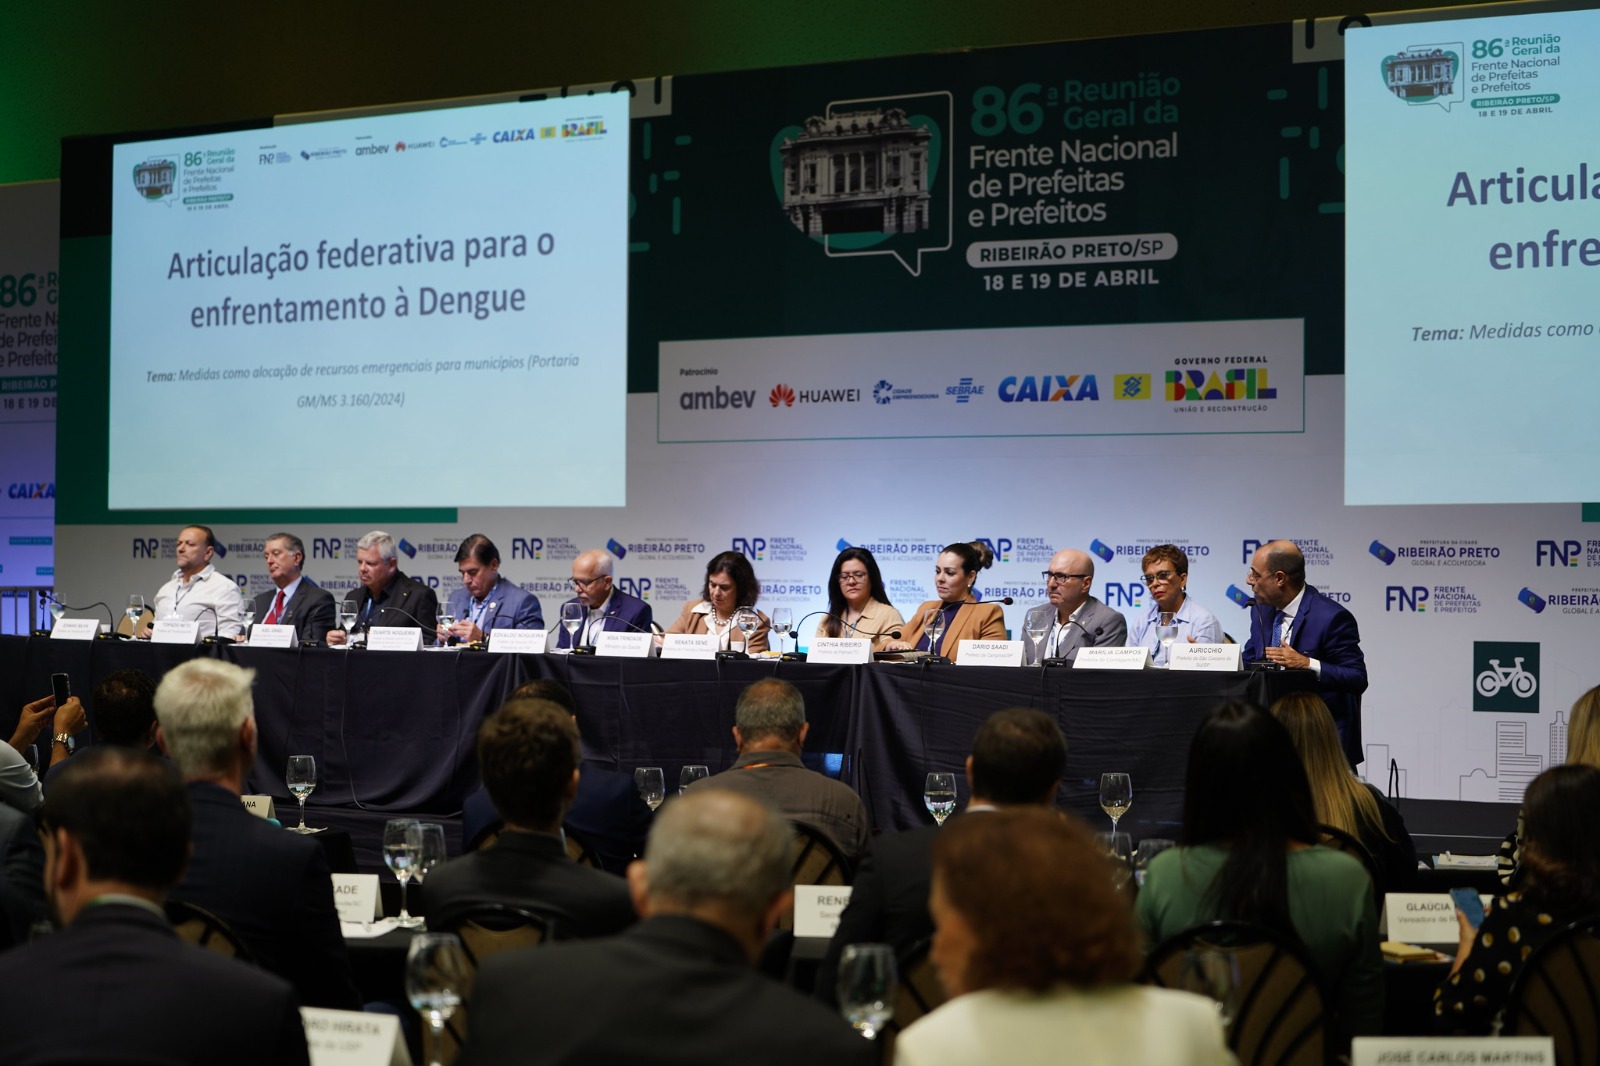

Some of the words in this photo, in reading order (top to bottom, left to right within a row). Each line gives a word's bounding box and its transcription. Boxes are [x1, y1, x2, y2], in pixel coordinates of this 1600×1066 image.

[1512, 33, 1561, 46] Reunião
[1512, 45, 1542, 56] Geral
[1546, 44, 1560, 54] da
[1472, 61, 1508, 71] Frente
[1511, 56, 1560, 70] Nacional
[1471, 73, 1486, 83] de
[1488, 70, 1538, 82] Prefeitas
[1064, 72, 1181, 103] Reunião
[1471, 85, 1479, 94] e
[1481, 81, 1531, 93] Prefeitos
[1476, 98, 1515, 107] RIBEIRÃO
[1516, 95, 1555, 105] PRETO/SP
[1063, 101, 1136, 130] Geral
[1143, 97, 1179, 125] da
[1510, 108, 1523, 116] DE
[1525, 106, 1553, 115] ABRIL
[492, 128, 535, 144] CAIXA
[355, 143, 390, 156] ambev
[970, 143, 1054, 170] Frente
[1061, 131, 1178, 164] Nacional
[968, 173, 1002, 199] de
[1008, 167, 1125, 197] Prefeitas
[968, 208, 985, 227] e
[991, 198, 1107, 227] Prefeitos
[167, 243, 309, 280] Articulação
[317, 234, 454, 270] federativa
[465, 234, 527, 267] para
[537, 233, 555, 255] o
[980, 241, 1066, 262] RIBEIRÃO
[1072, 239, 1164, 259] PRETO/SP
[1489, 229, 1600, 270] enfre
[983, 275, 1004, 291] 18
[1011, 274, 1024, 290] E
[1030, 273, 1051, 289] 19
[1059, 271, 1087, 288] DE
[1094, 268, 1159, 287] ABRIL
[191, 292, 386, 328] enfrentamento
[394, 286, 409, 317] à
[419, 287, 526, 320] Dengue
[1412, 326, 1465, 342] Tema:
[1469, 322, 1542, 339] Medidas
[1547, 324, 1594, 337] como
[147, 370, 176, 383] Tema:
[178, 367, 221, 381] Medidas
[223, 370, 250, 380] como
[253, 364, 298, 380] alocação
[300, 363, 313, 377] de
[315, 363, 359, 376] recursos
[362, 359, 433, 376] emergenciais
[435, 360, 461, 374] para
[464, 356, 524, 374] municípios
[527, 353, 579, 371] (Portaria
[1174, 357, 1221, 366] GOVERNO
[1225, 355, 1268, 364] FEDERAL
[680, 367, 718, 377] Patrocínio
[2, 377, 47, 391] RIBEIRÃO
[945, 385, 985, 395] SEBRAE
[998, 374, 1100, 403] CAIXA
[1165, 368, 1277, 401] BRASIL
[4, 398, 14, 409] 18
[18, 398, 25, 409] E
[28, 397, 39, 409] 19
[680, 385, 756, 410] ambev
[800, 389, 861, 403] HUAWEI
[1174, 405, 1197, 413] UNIÃO
[1207, 404, 1268, 413] RECONSTRUÇÃO
[8, 482, 55, 499] CAIXA
[133, 538, 159, 559] FNP
[313, 538, 341, 559] FNP
[418, 543, 458, 552] RIBEIRÃO
[512, 538, 543, 560] FNP
[628, 543, 672, 553] RIBEIRÃO
[674, 544, 705, 553] PRETO
[732, 538, 766, 560] FNP
[911, 544, 944, 554] PRETO
[1398, 546, 1456, 558] RIBEIRÃO
[1459, 547, 1500, 558] PRETO
[1536, 540, 1582, 567] FNP
[619, 578, 651, 600] FNP
[789, 586, 821, 595] PRETO
[985, 587, 1035, 598] RIBEIRÃO
[1105, 582, 1144, 607] FNP
[1386, 586, 1430, 612] FNP
[1397, 916, 1436, 924] Vereadora
